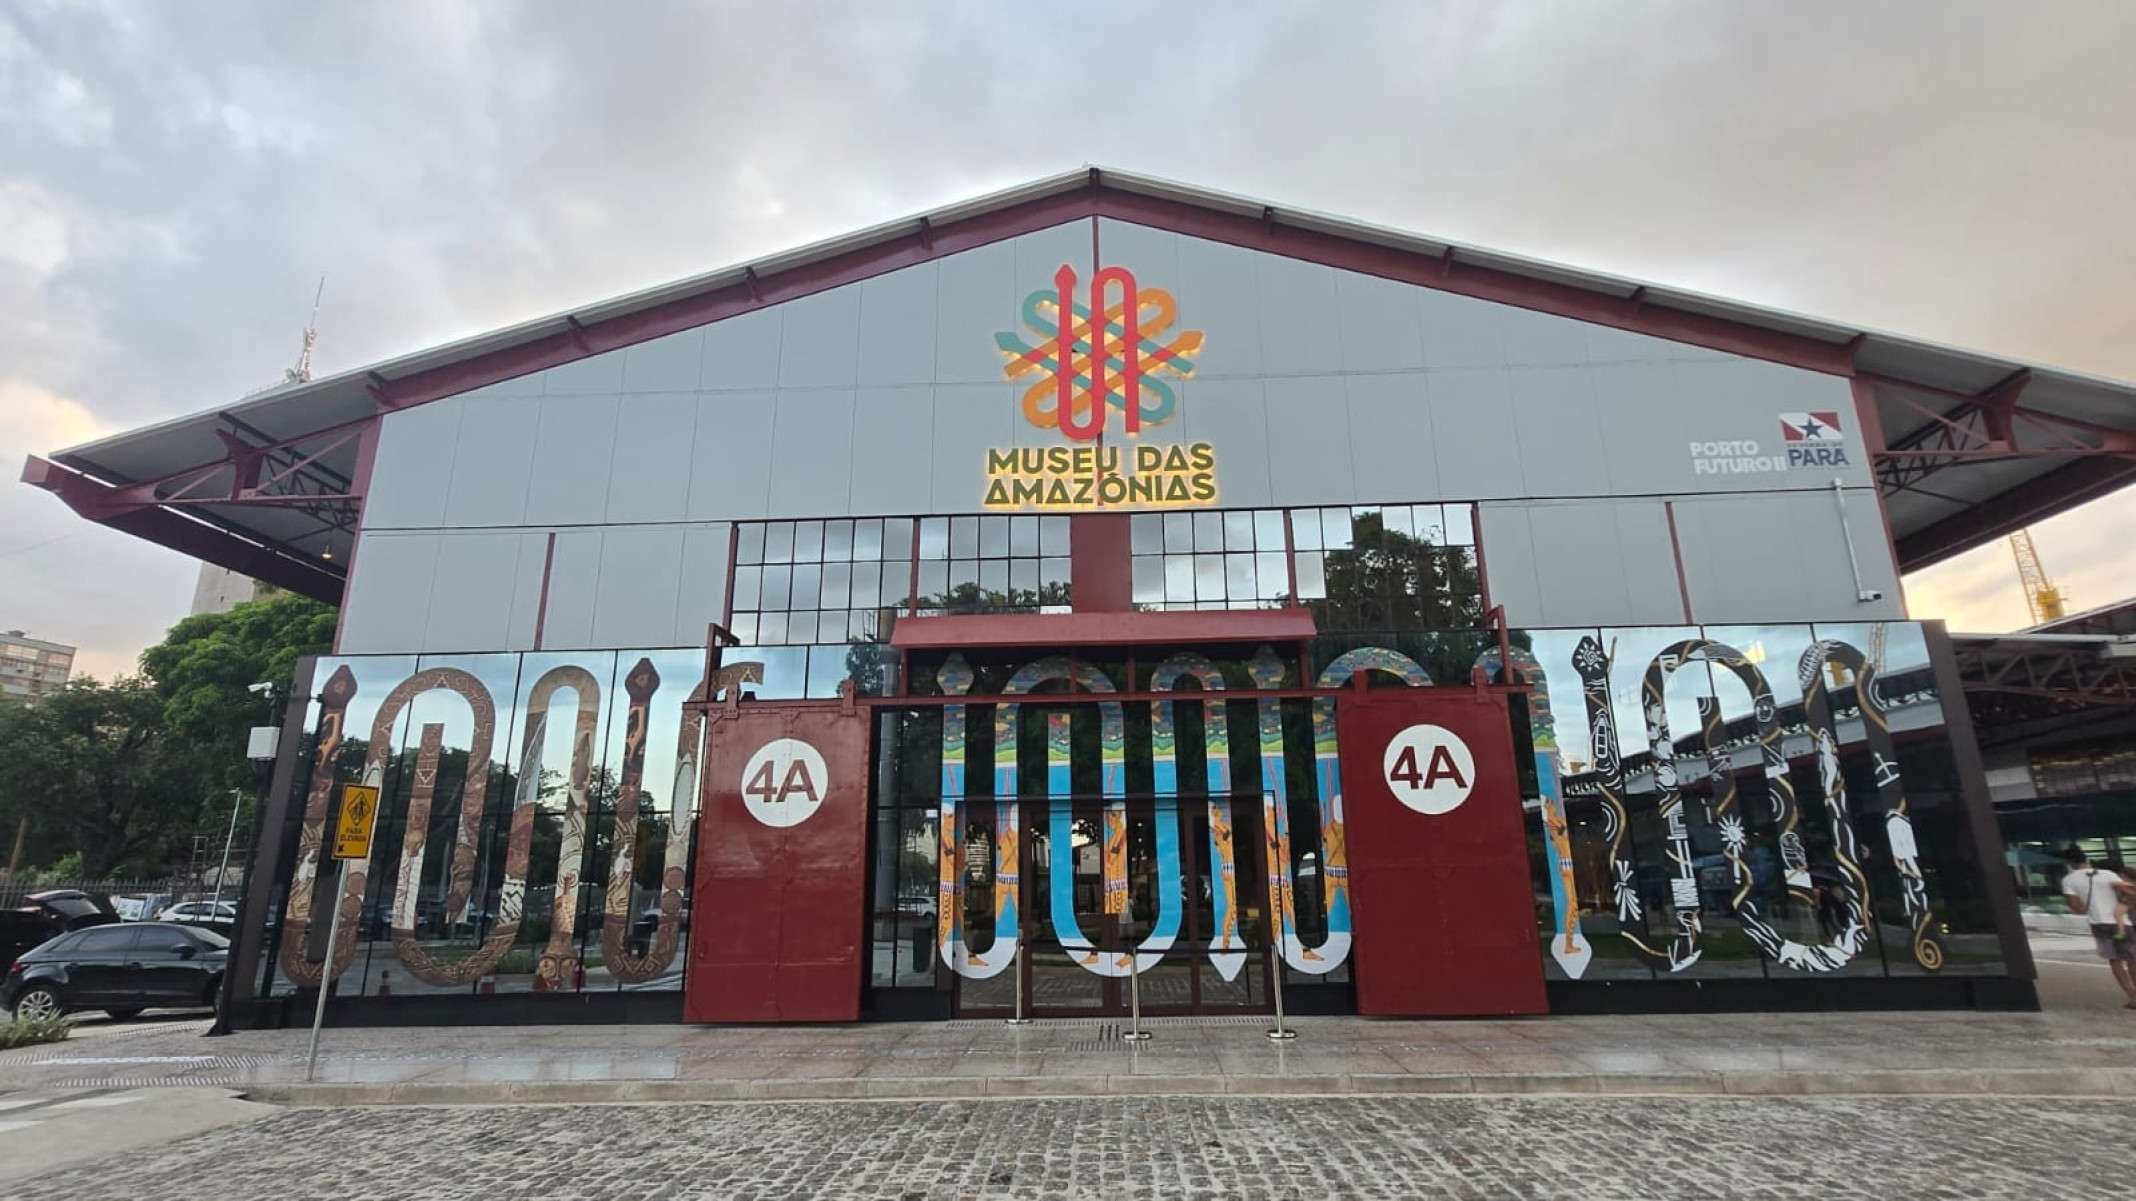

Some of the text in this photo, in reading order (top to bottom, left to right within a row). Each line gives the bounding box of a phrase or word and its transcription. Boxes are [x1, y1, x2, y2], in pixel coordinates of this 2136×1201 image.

[988, 443, 1214, 474] MUSEU DAS
[1690, 440, 1759, 457] PORTO
[984, 472, 1216, 505] AMAZÔNIAS
[745, 760, 818, 803] 4A
[1390, 745, 1467, 789] 4A
